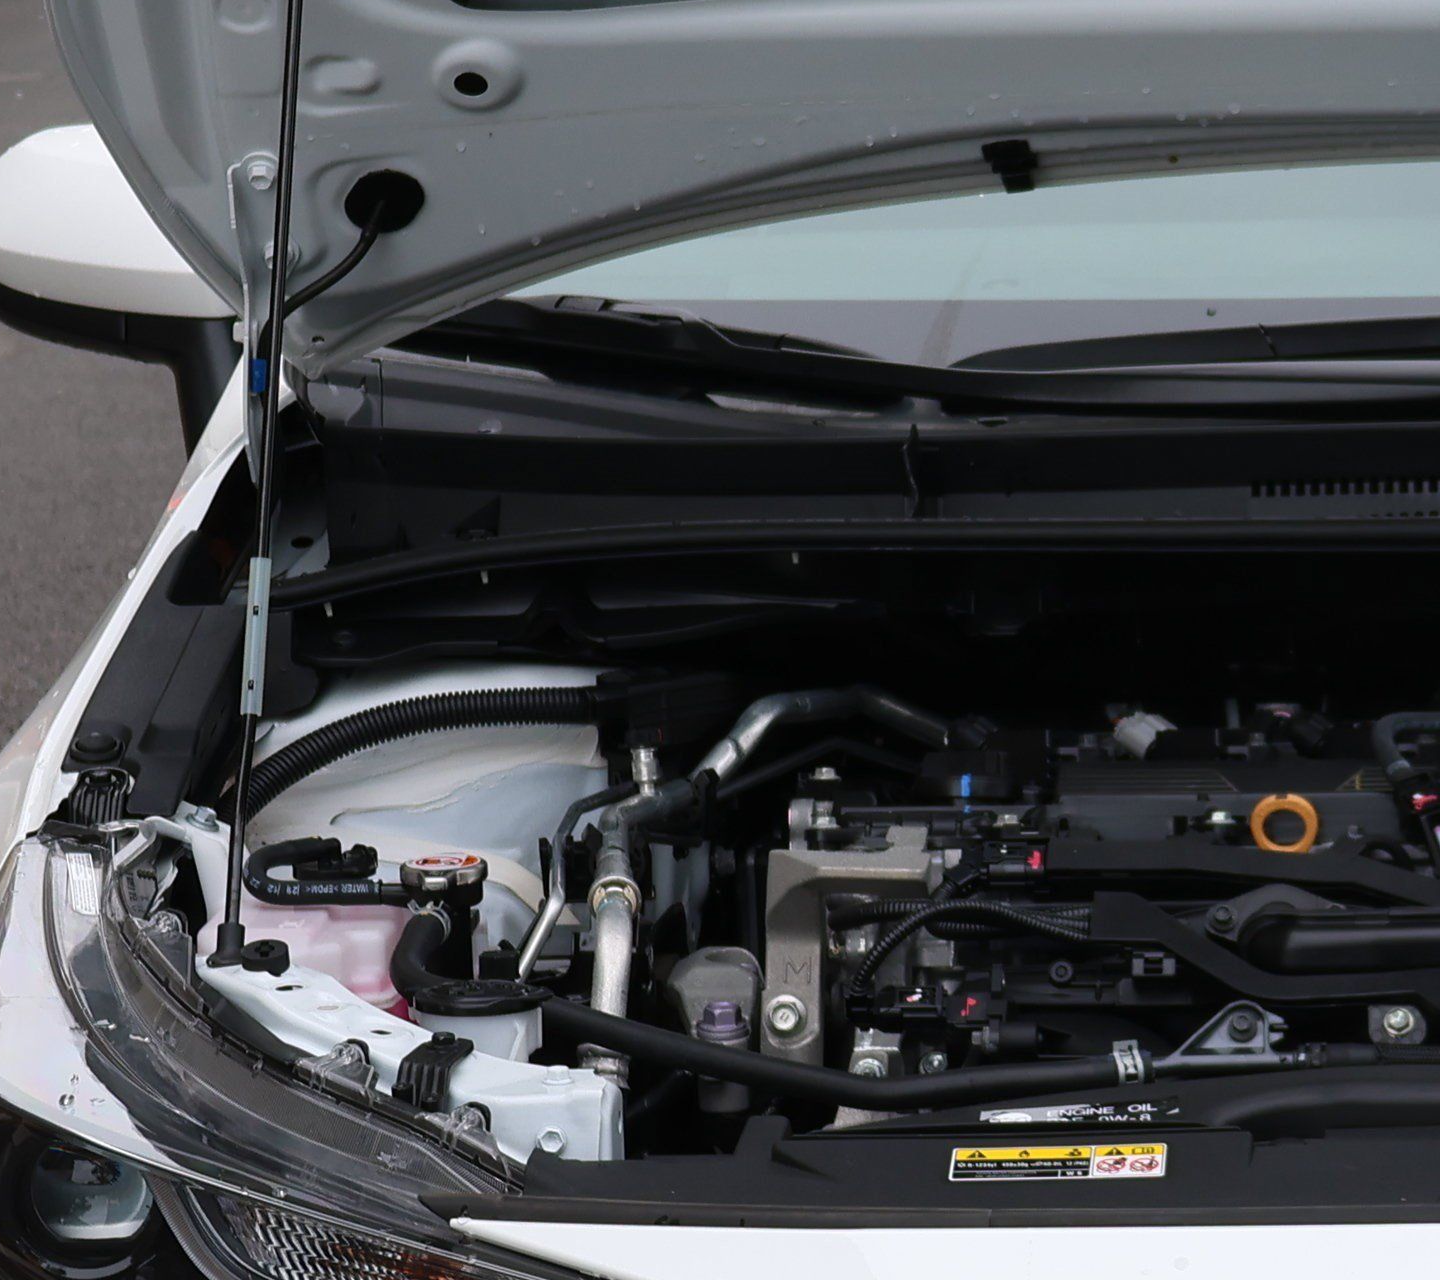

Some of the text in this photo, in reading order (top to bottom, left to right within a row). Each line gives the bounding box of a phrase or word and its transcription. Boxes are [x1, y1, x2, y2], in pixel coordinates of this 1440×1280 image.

[340, 883, 369, 894] WATER
[1047, 1103, 1158, 1118] ENGINE OIL
